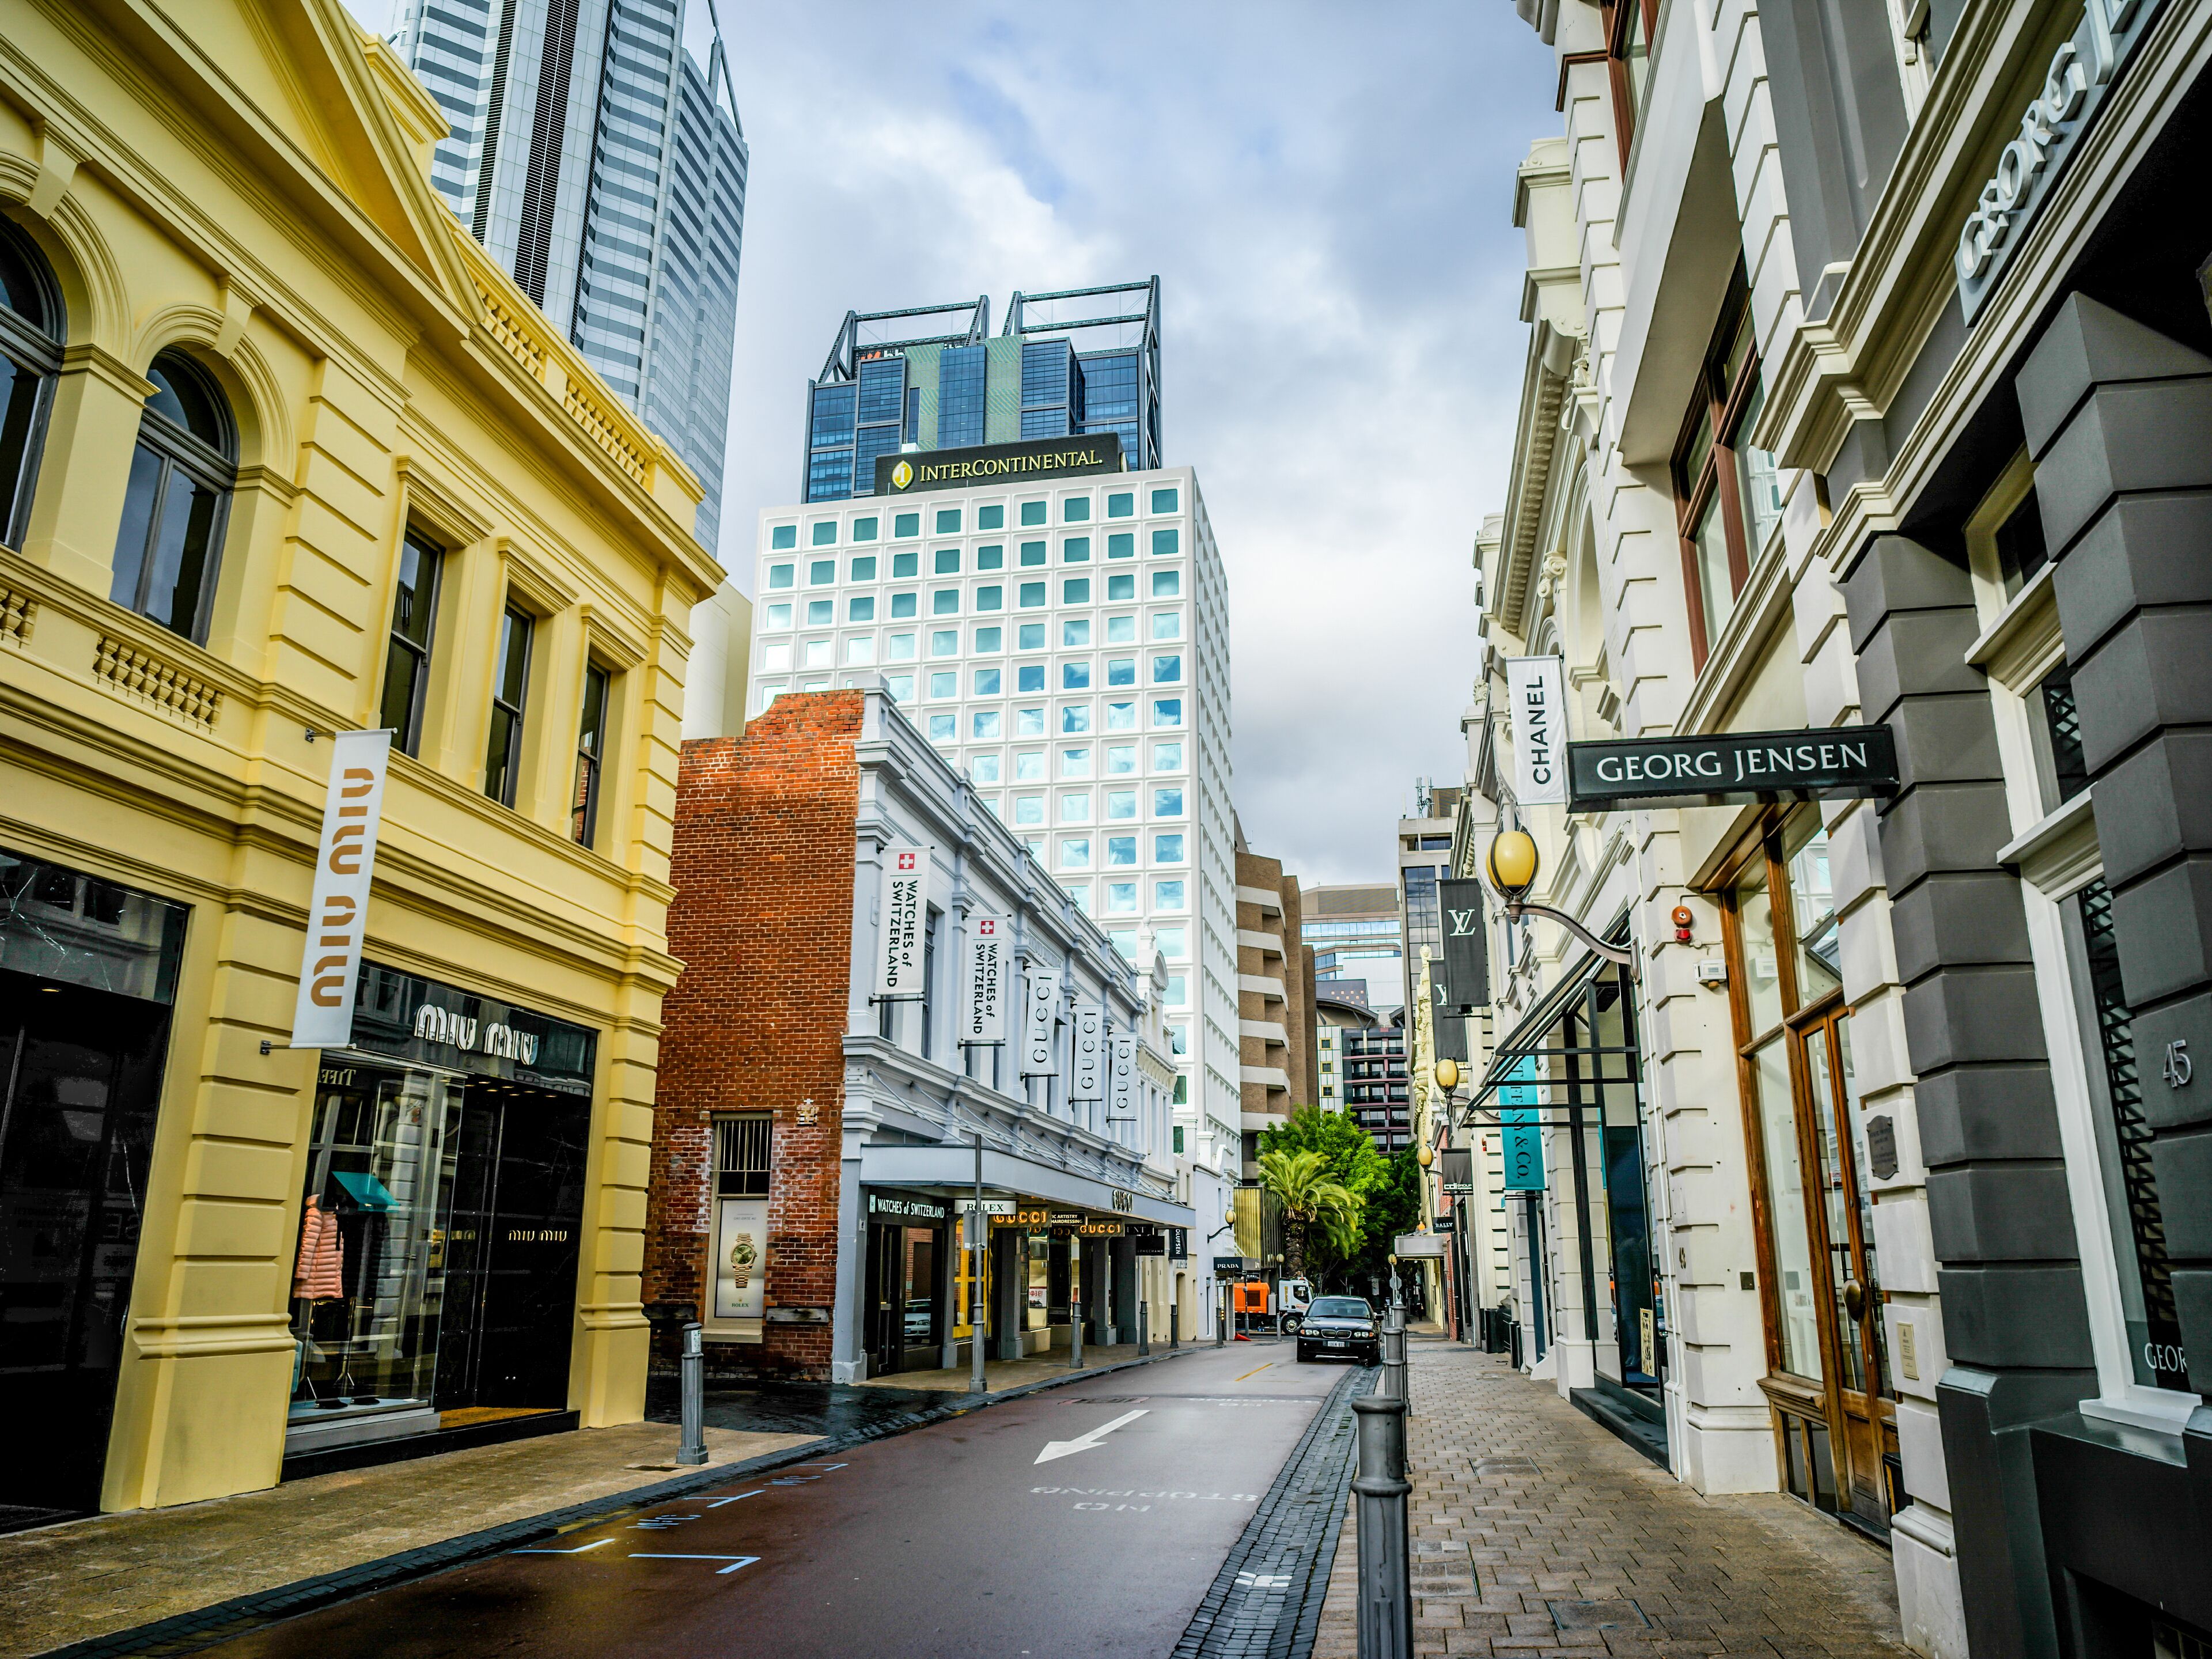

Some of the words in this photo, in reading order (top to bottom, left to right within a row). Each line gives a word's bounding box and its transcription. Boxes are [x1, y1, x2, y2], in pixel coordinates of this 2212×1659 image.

[1959, 41, 2086, 279] GEORG
[920, 450, 1099, 482] INTERCONTINENTAL
[1527, 675, 1552, 785] CHANEL
[1596, 752, 1722, 782] GEORG
[1734, 743, 1868, 782] JENSEN
[903, 880, 918, 949] WATCHES
[1448, 909, 1476, 936] LV
[888, 881, 904, 987] SWITZERLAND
[903, 953, 912, 967] of
[986, 943, 998, 1001] WATCHES
[973, 944, 986, 1034] SWITZERLAND
[985, 1005, 995, 1018] of
[1033, 976, 1052, 1063] GUCCI
[1081, 1012, 1097, 1089] GUCCI
[2162, 1040, 2192, 1088] 45
[1116, 1040, 1131, 1109] GUCCI
[1515, 1136, 1528, 1148] &
[1516, 1152, 1531, 1179] CO.
[877, 1198, 903, 1214] WATCHES
[903, 1201, 910, 1214] of
[911, 1203, 945, 1218] SWITZERLAND
[967, 1203, 1004, 1211] RLEX
[993, 1211, 1047, 1224] GUCCI
[1112, 1190, 1134, 1212] GUCCI
[1080, 1224, 1120, 1234] GUCCI
